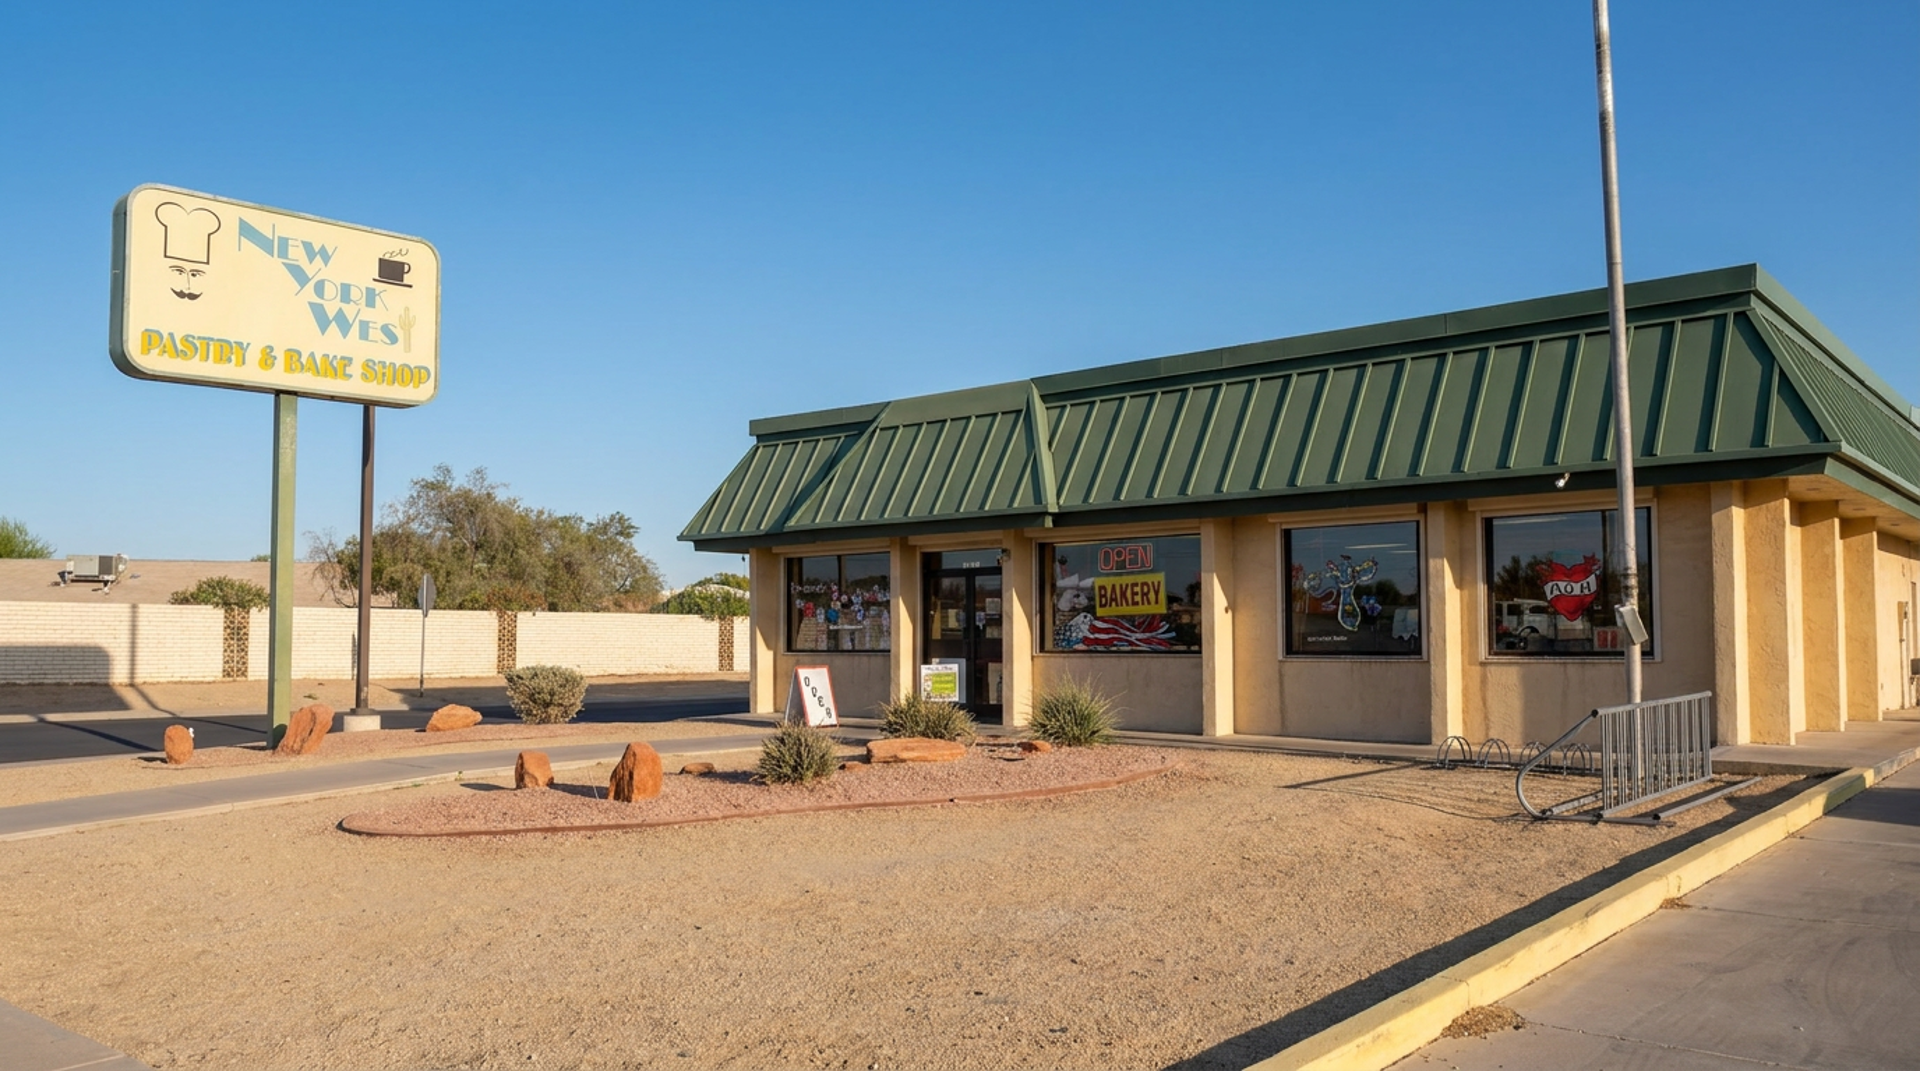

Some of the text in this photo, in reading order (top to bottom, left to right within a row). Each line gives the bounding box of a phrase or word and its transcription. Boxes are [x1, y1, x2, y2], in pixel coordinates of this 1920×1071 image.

[237, 216, 338, 268] NEW
[281, 261, 389, 312] YORK
[141, 328, 431, 389] PASTRY & BAKE SHOP
[1100, 544, 1152, 571] OPEN
[1098, 580, 1161, 608] BAKERY
